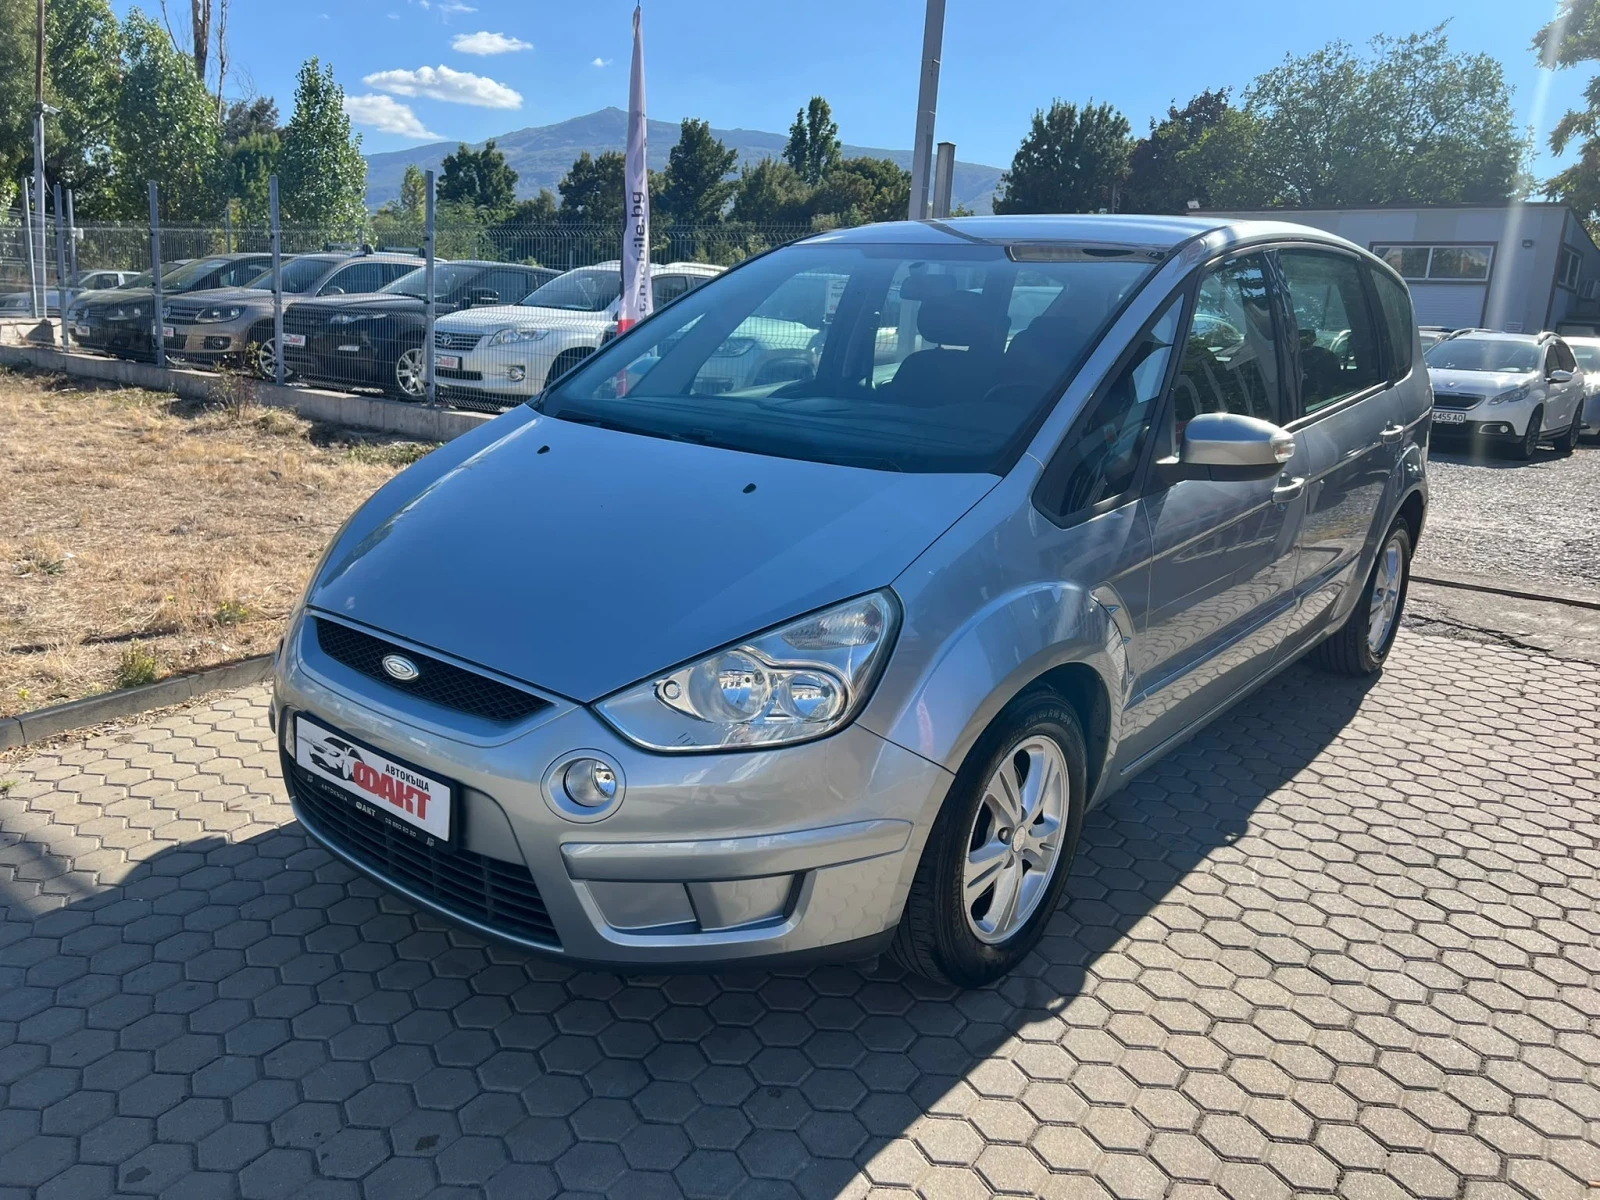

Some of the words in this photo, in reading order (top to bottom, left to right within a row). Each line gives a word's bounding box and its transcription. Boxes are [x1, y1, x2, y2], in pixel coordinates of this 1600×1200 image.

[1432, 412, 1452, 421] 6455
[385, 763, 430, 792] АВТОКЪЩА
[353, 760, 432, 821] ФАКТ
[355, 801, 376, 817] ФАКТ
